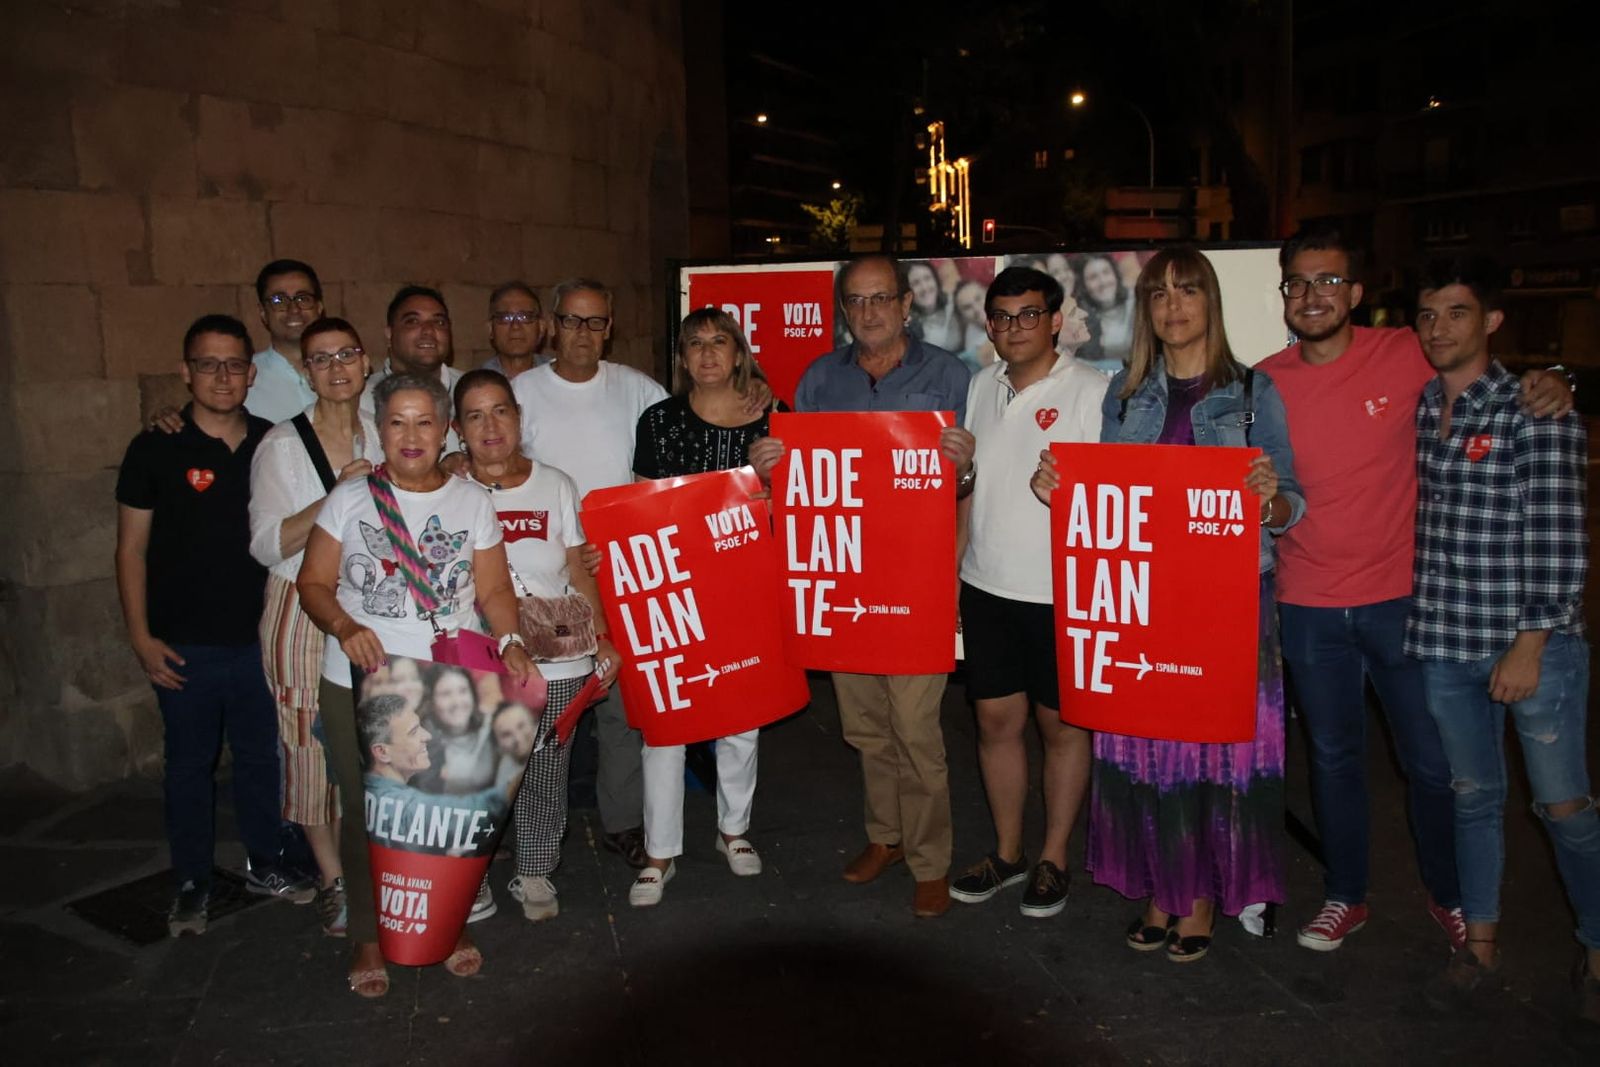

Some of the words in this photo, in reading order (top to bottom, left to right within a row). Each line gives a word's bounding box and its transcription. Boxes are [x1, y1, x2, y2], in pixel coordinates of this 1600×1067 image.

[783, 303, 822, 325] VOTA
[785, 448, 864, 508] ADE
[892, 449, 942, 475] VOTA
[704, 504, 756, 539] VOTA
[1066, 482, 1153, 553] ADE
[1187, 488, 1244, 520] VOTA
[608, 524, 692, 597] ADE
[786, 514, 863, 574] LAN
[787, 578, 837, 637] TE
[1066, 555, 1150, 626] LAN
[619, 587, 706, 656] LAN
[636, 654, 692, 713] TE
[1066, 626, 1120, 694] TE
[381, 885, 428, 920] VOTA
[382, 871, 405, 886] ESPAÑA
[407, 877, 432, 890] AVANZA
